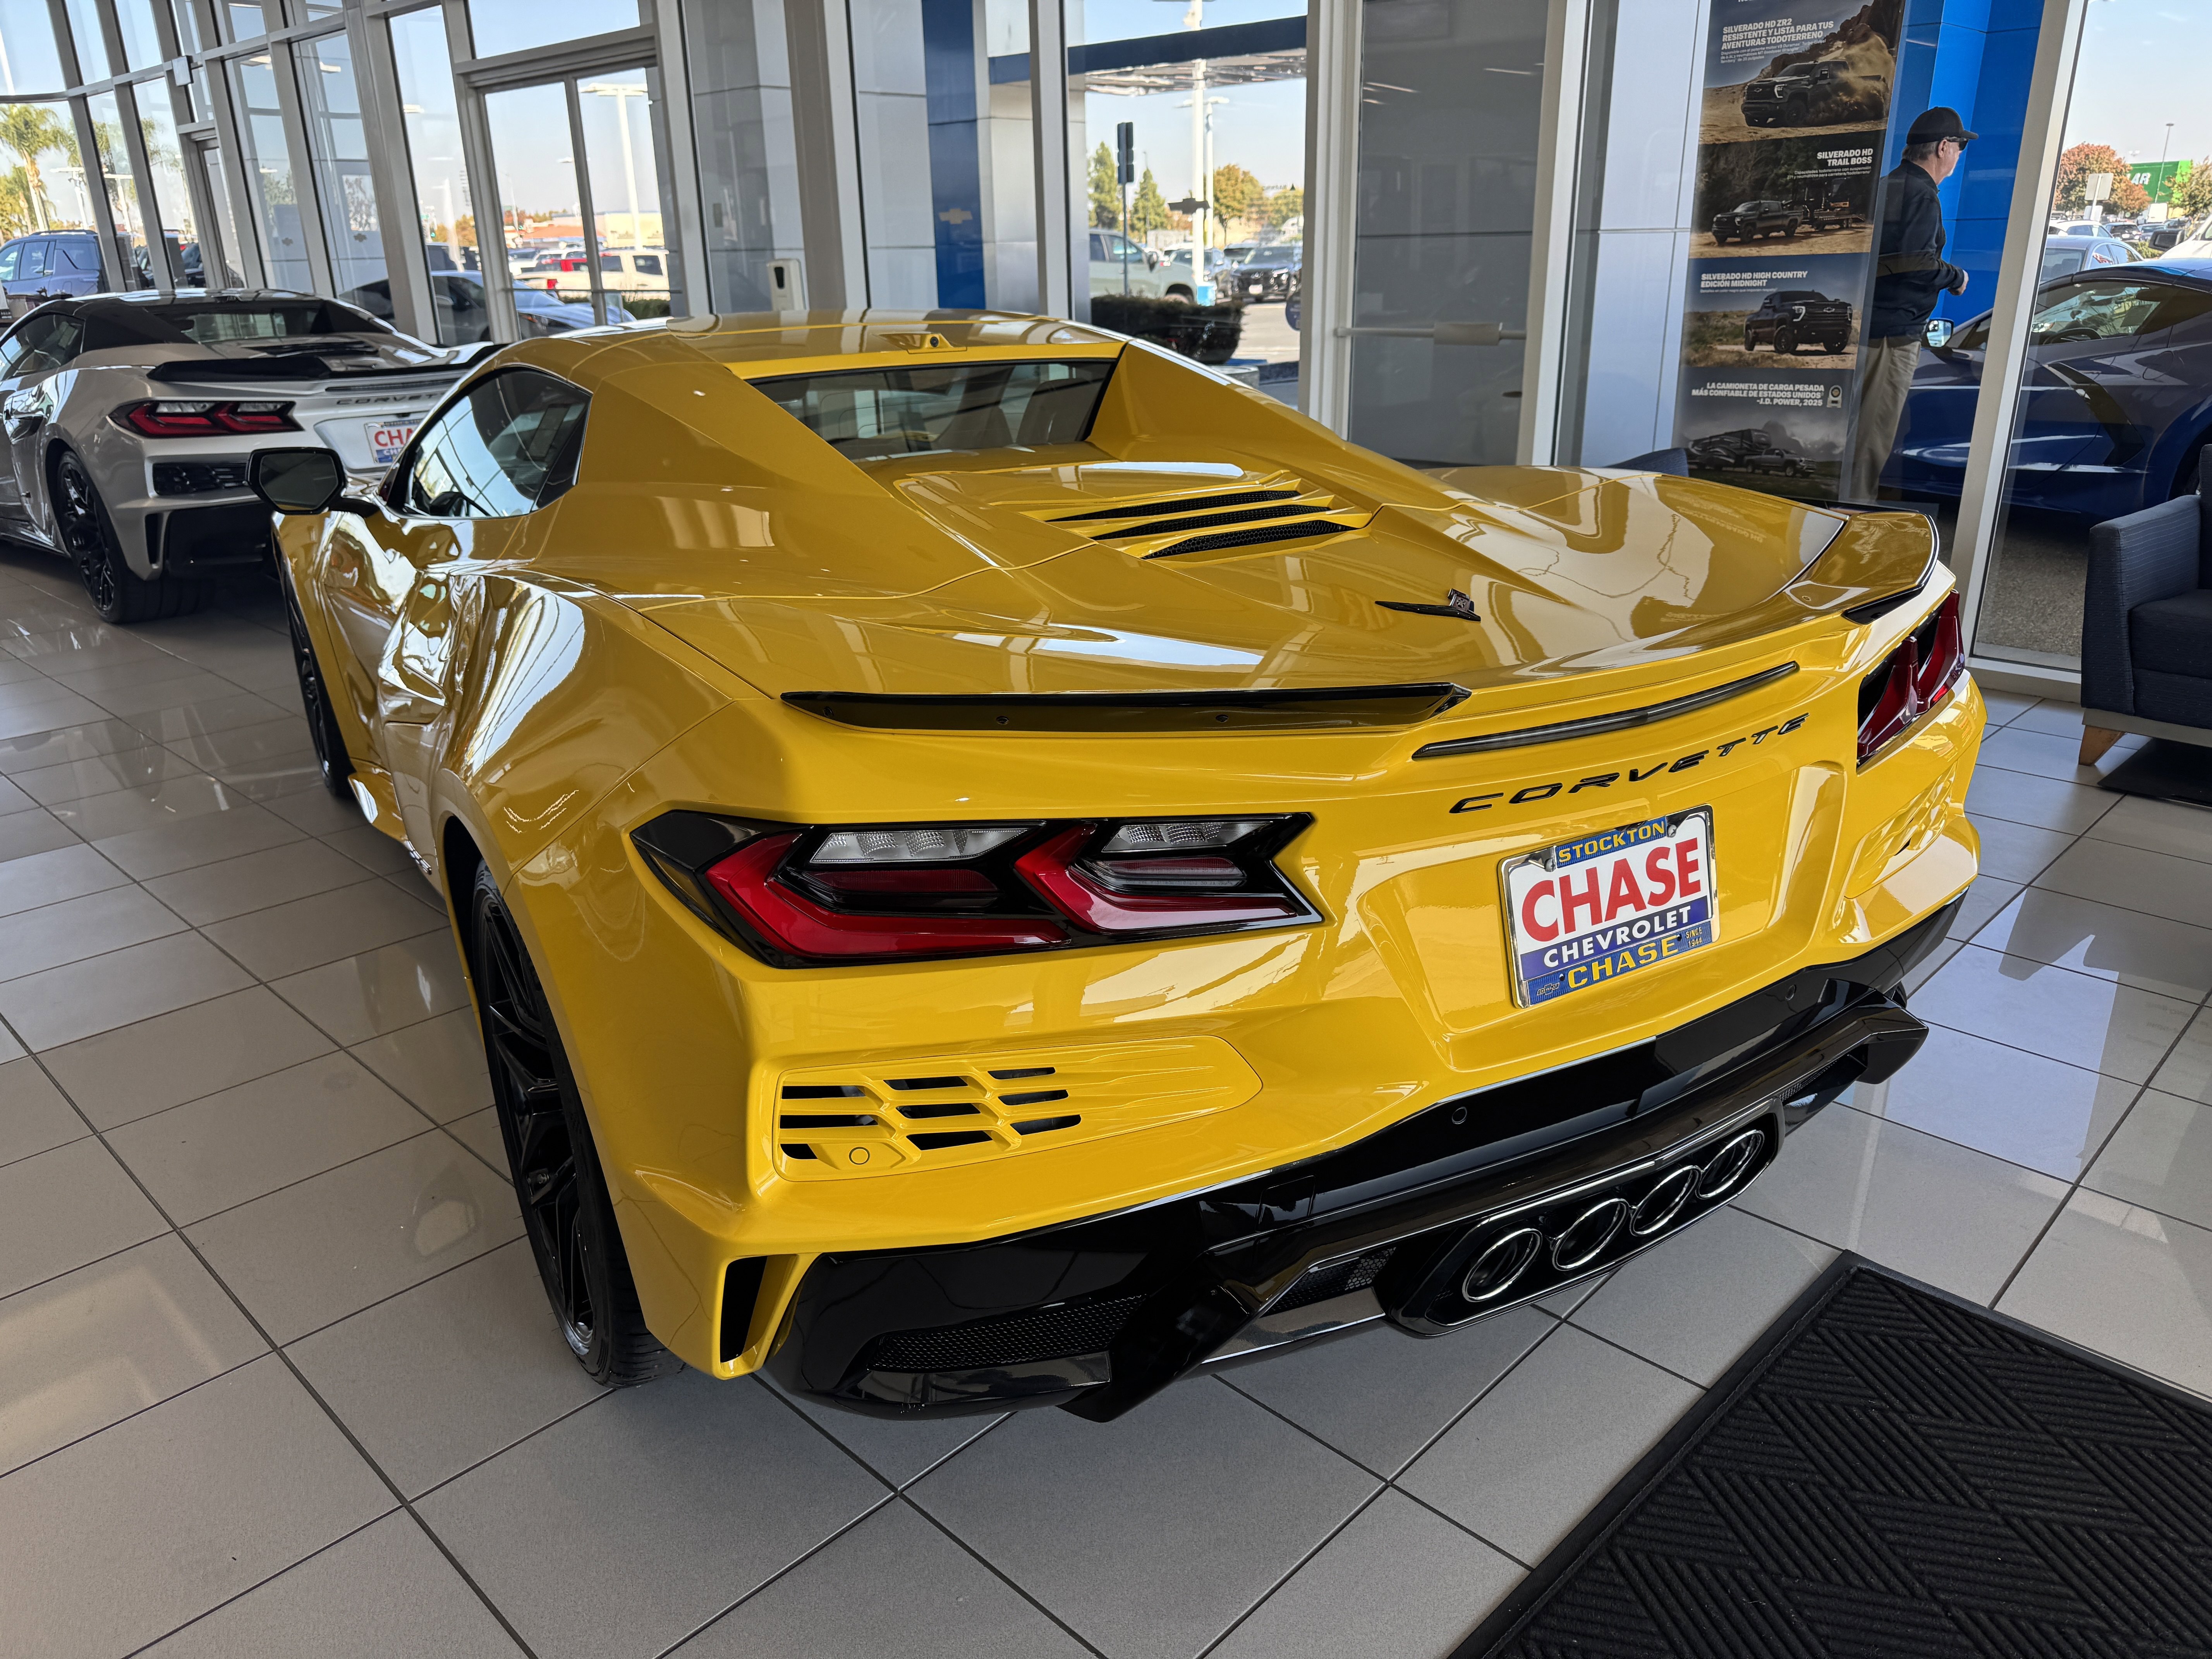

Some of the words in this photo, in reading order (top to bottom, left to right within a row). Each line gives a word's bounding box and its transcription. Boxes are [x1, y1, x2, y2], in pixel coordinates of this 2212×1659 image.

[1723, 22, 1764, 34] SILVERADO
[1765, 20, 1776, 28] HD
[1723, 29, 1767, 42] RESISTENTE
[1774, 26, 1795, 35] LISTA
[1796, 23, 1817, 33] PARA
[1818, 21, 1834, 29] TUS
[1721, 38, 1766, 50] AVENTURAS
[1767, 31, 1823, 44] TODOTERRENO
[1817, 149, 1861, 159] SILVERADO
[1827, 158, 1850, 166] TRAIL
[1851, 156, 1872, 165] BOSS
[337, 392, 445, 405] CORVET
[1692, 387, 1708, 396] MÁS
[1773, 398, 1802, 407] POWER,
[1448, 712, 1810, 814] CORVETTE
[1559, 821, 1664, 863] STOCKTON
[1522, 837, 1701, 942] CHASE
[1544, 906, 1691, 967] CHEVROLET
[1686, 927, 1702, 939] SINCE
[1688, 937, 1702, 948] 1944
[1568, 935, 1679, 989] CHASE
